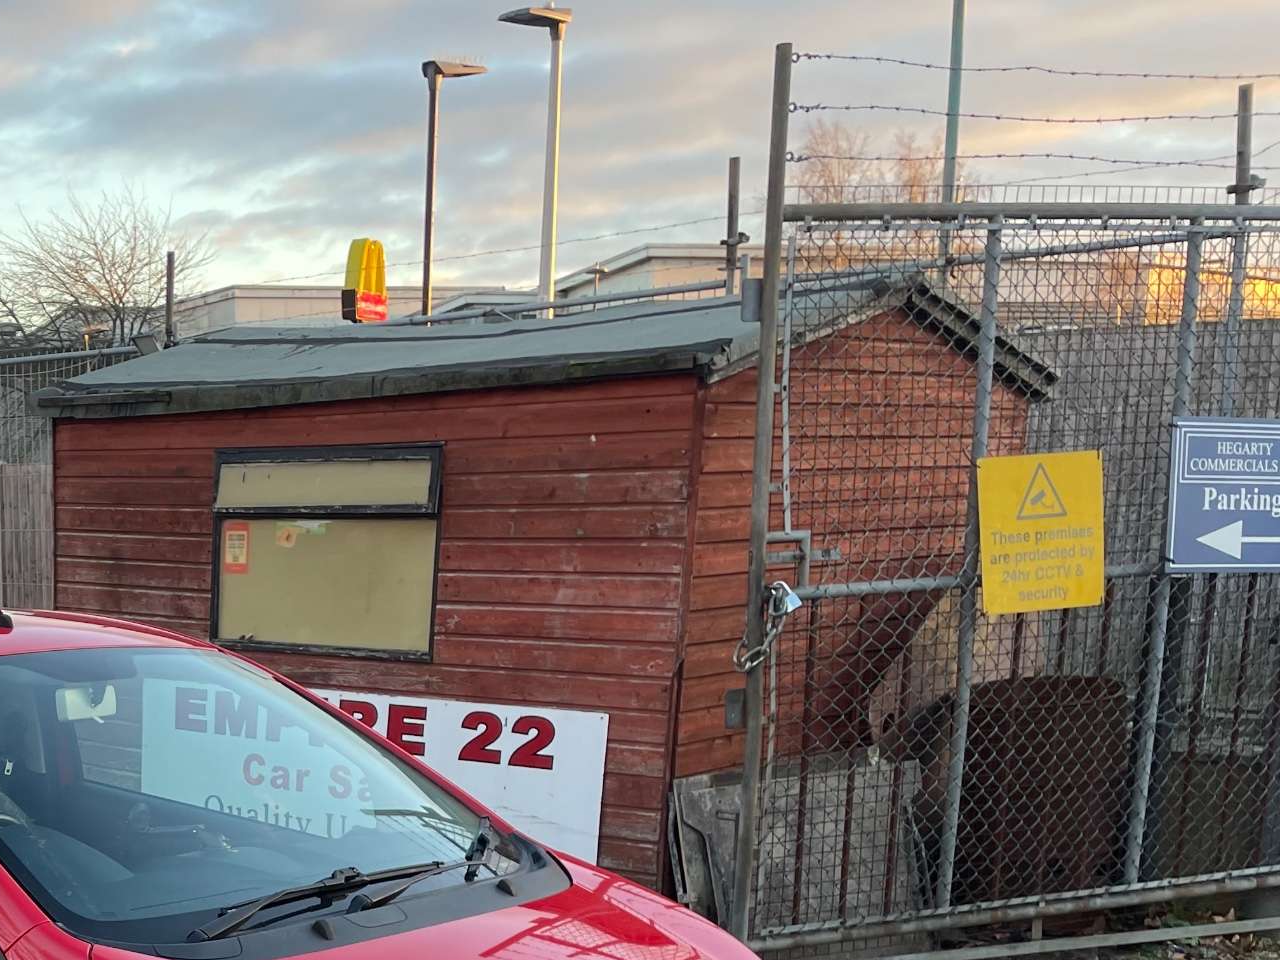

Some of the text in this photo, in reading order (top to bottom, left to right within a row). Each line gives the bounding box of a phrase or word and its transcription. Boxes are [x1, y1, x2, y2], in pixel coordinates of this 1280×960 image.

[1216, 441, 1274, 456] HEGARTY
[1190, 457, 1279, 473] COMMERCIALS
[1202, 487, 1280, 518] Parking
[991, 524, 1094, 545] These premises
[990, 553, 1011, 565] are
[1015, 544, 1077, 567] protected
[1018, 583, 1068, 601] security
[457, 711, 556, 770] 22
[243, 752, 311, 793] Car
